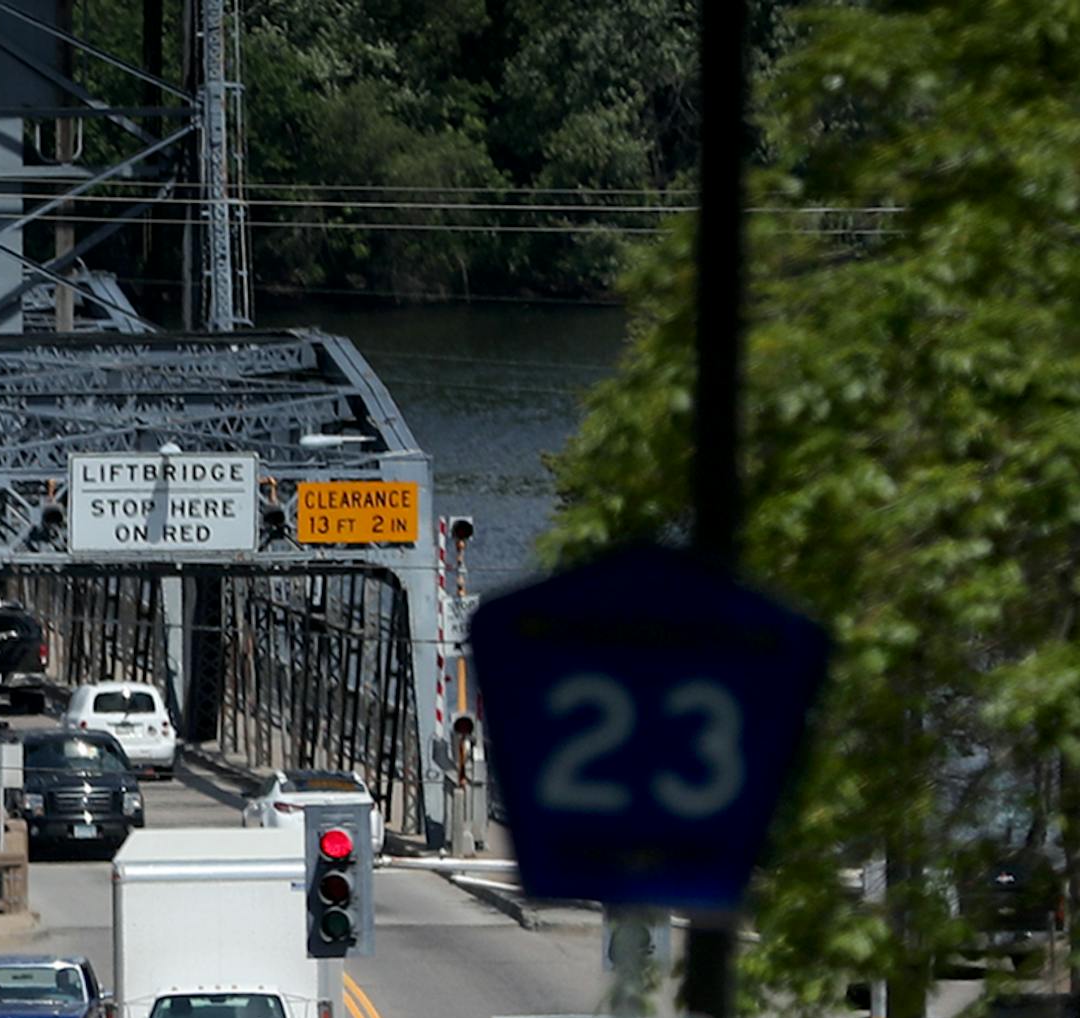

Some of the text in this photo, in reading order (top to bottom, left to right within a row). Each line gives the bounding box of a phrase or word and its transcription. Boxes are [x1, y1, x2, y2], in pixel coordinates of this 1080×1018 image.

[82, 463, 245, 482] LIFTBRIDGE
[91, 499, 236, 518] STOP HERE
[304, 489, 412, 509] CLEARANCE
[115, 524, 211, 543] ON RED
[308, 515, 408, 534] 13 FT 2 IN
[536, 673, 747, 818] 23
